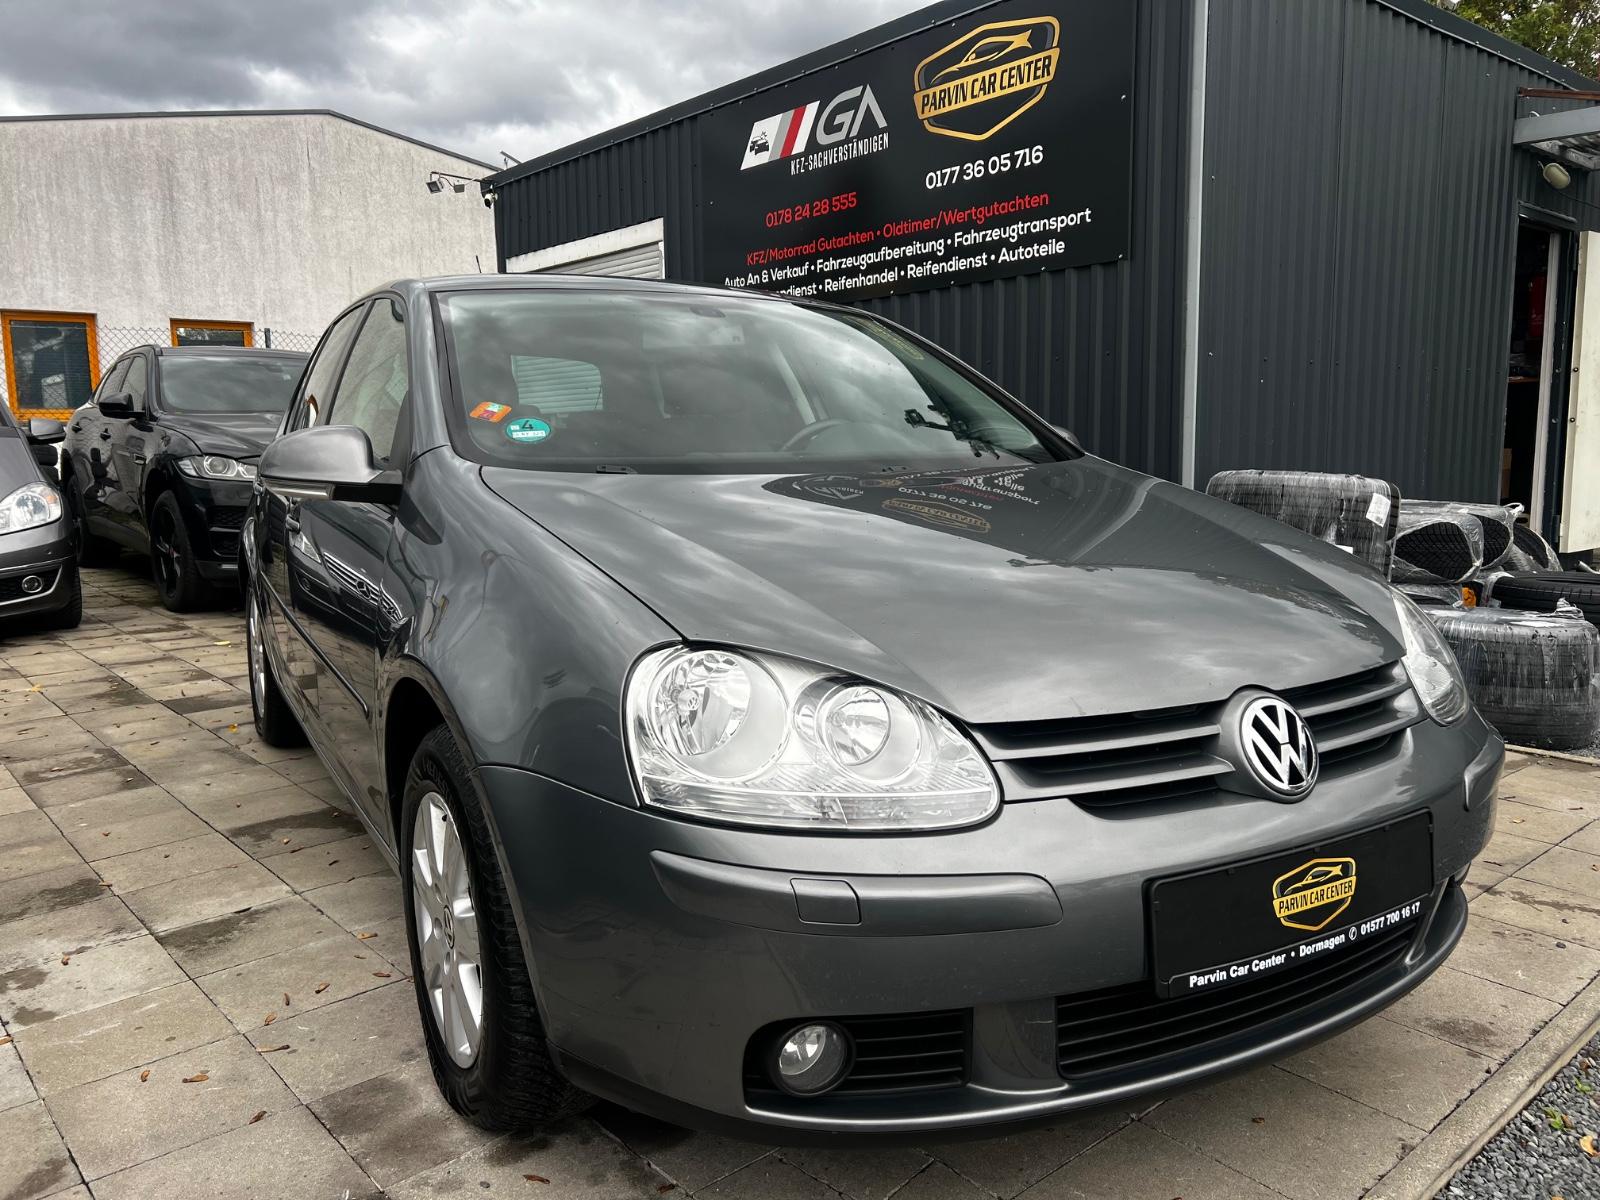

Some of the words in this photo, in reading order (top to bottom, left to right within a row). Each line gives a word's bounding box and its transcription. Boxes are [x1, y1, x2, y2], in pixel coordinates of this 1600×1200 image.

[920, 80, 969, 115] PARVIN
[970, 72, 997, 98] CAR
[999, 54, 1052, 91] CENTER
[790, 132, 889, 176] KFZ-SACHVERSTÄNDIGEN
[925, 166, 961, 189] 0177
[962, 160, 985, 181] 36
[988, 153, 1011, 174] 05
[1014, 145, 1044, 169] 716
[746, 240, 816, 266] KFZ/Motorrad
[817, 230, 875, 251] Gutachten
[882, 193, 1049, 238] Oldtimer/Wertgutachten
[765, 208, 792, 228] 0178
[794, 203, 810, 222] 24
[813, 199, 829, 218] 28
[831, 192, 857, 212] 555
[724, 276, 746, 288] Auto
[747, 272, 760, 286] An
[761, 269, 769, 283] &
[770, 262, 809, 281] Verkauf
[816, 239, 945, 273] Fahrzeugaufbereitung
[954, 207, 1092, 248] Fahrzeugtransport
[824, 267, 898, 293] Reifenhandel
[907, 252, 988, 279] Reifendienst
[998, 238, 1066, 264] Autoteile
[1278, 894, 1309, 914] PARVIN
[1309, 888, 1325, 905] CAR
[1326, 880, 1353, 901] CENTER
[1189, 970, 1227, 988] Parvin
[1229, 965, 1249, 979] Car
[1251, 954, 1286, 972] Center
[1299, 934, 1345, 957] Dormagen
[1360, 917, 1384, 936] 01577
[1386, 912, 1400, 926] 700
[1401, 906, 1411, 919] 16
[1411, 901, 1421, 914] 17
